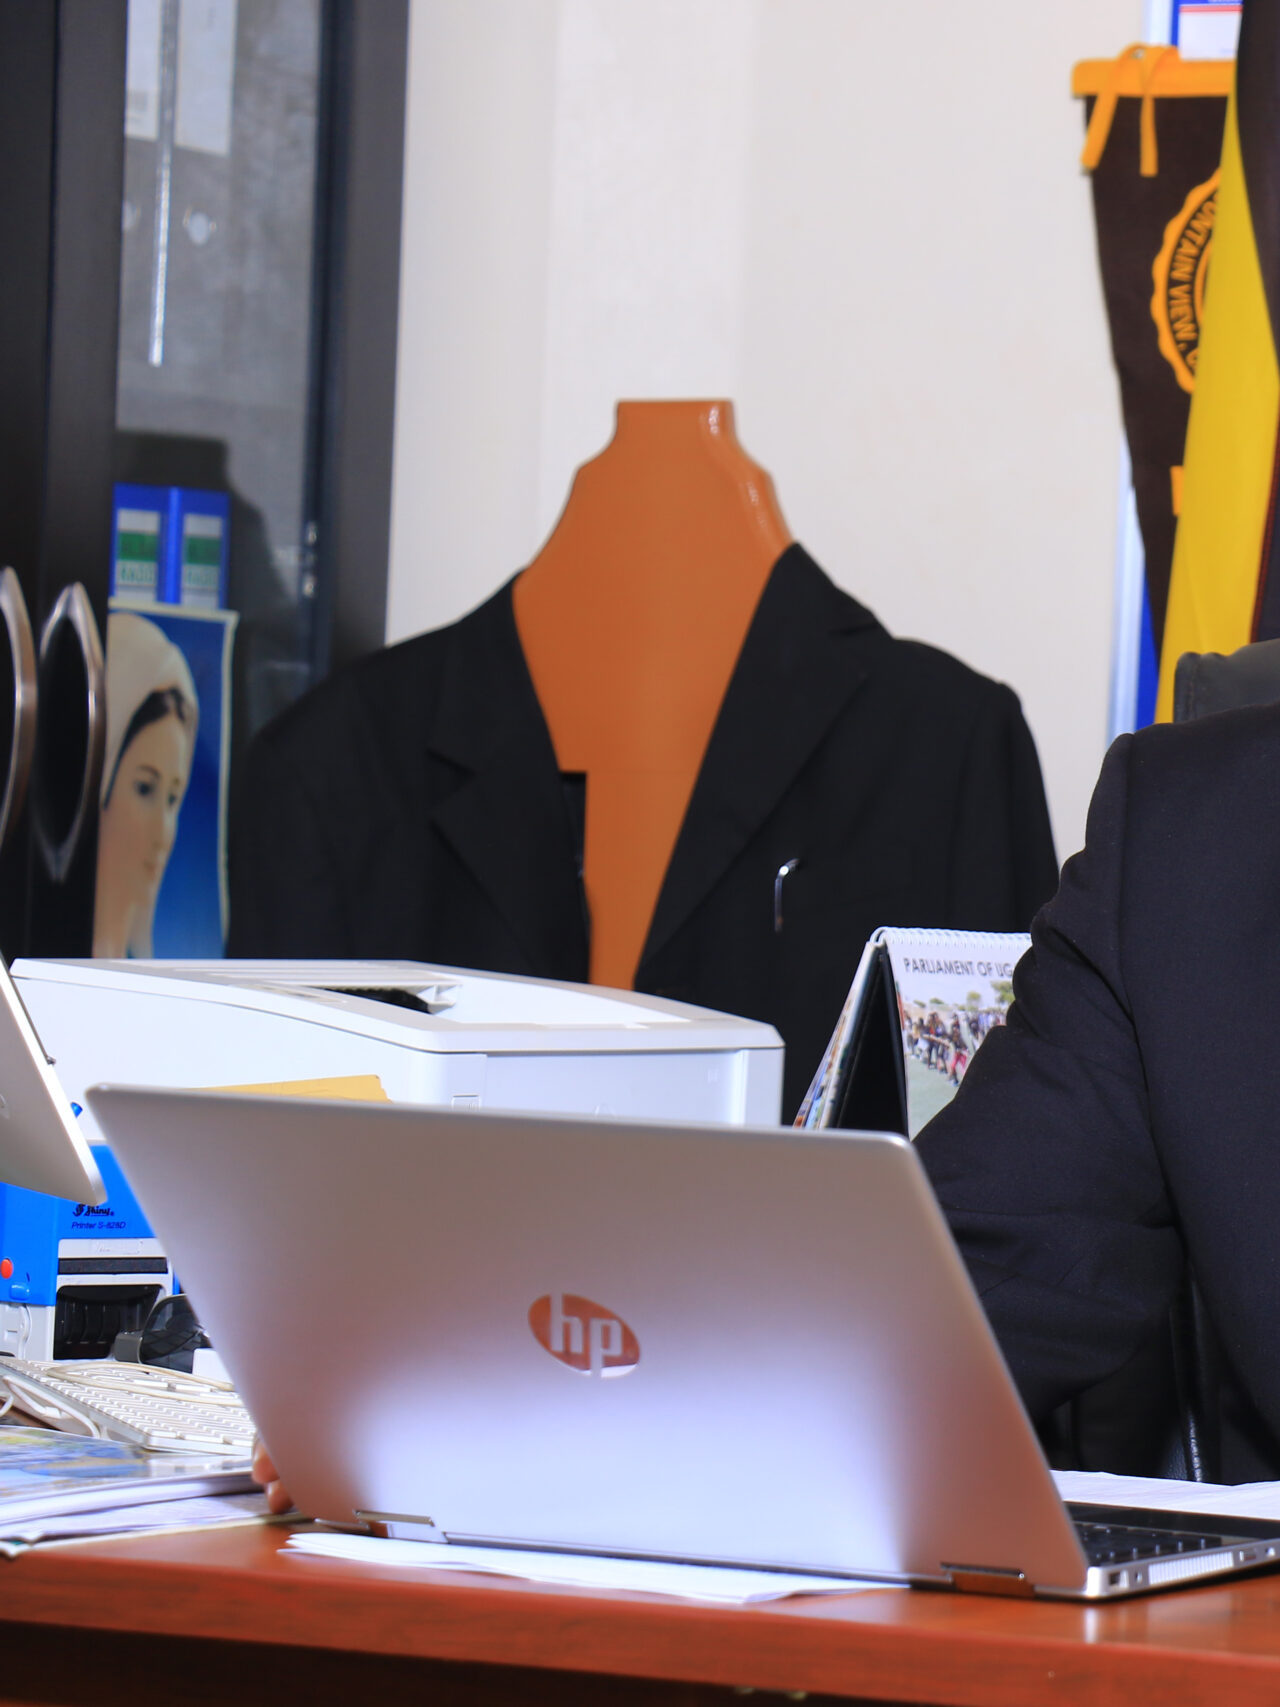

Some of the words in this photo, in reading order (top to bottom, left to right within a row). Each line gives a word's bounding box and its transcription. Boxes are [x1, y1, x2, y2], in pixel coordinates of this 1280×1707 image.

[903, 958, 974, 977] PARLIAMENT
[977, 961, 992, 977] OF
[72, 1221, 96, 1230] Printer
[550, 1293, 622, 1379] hp
